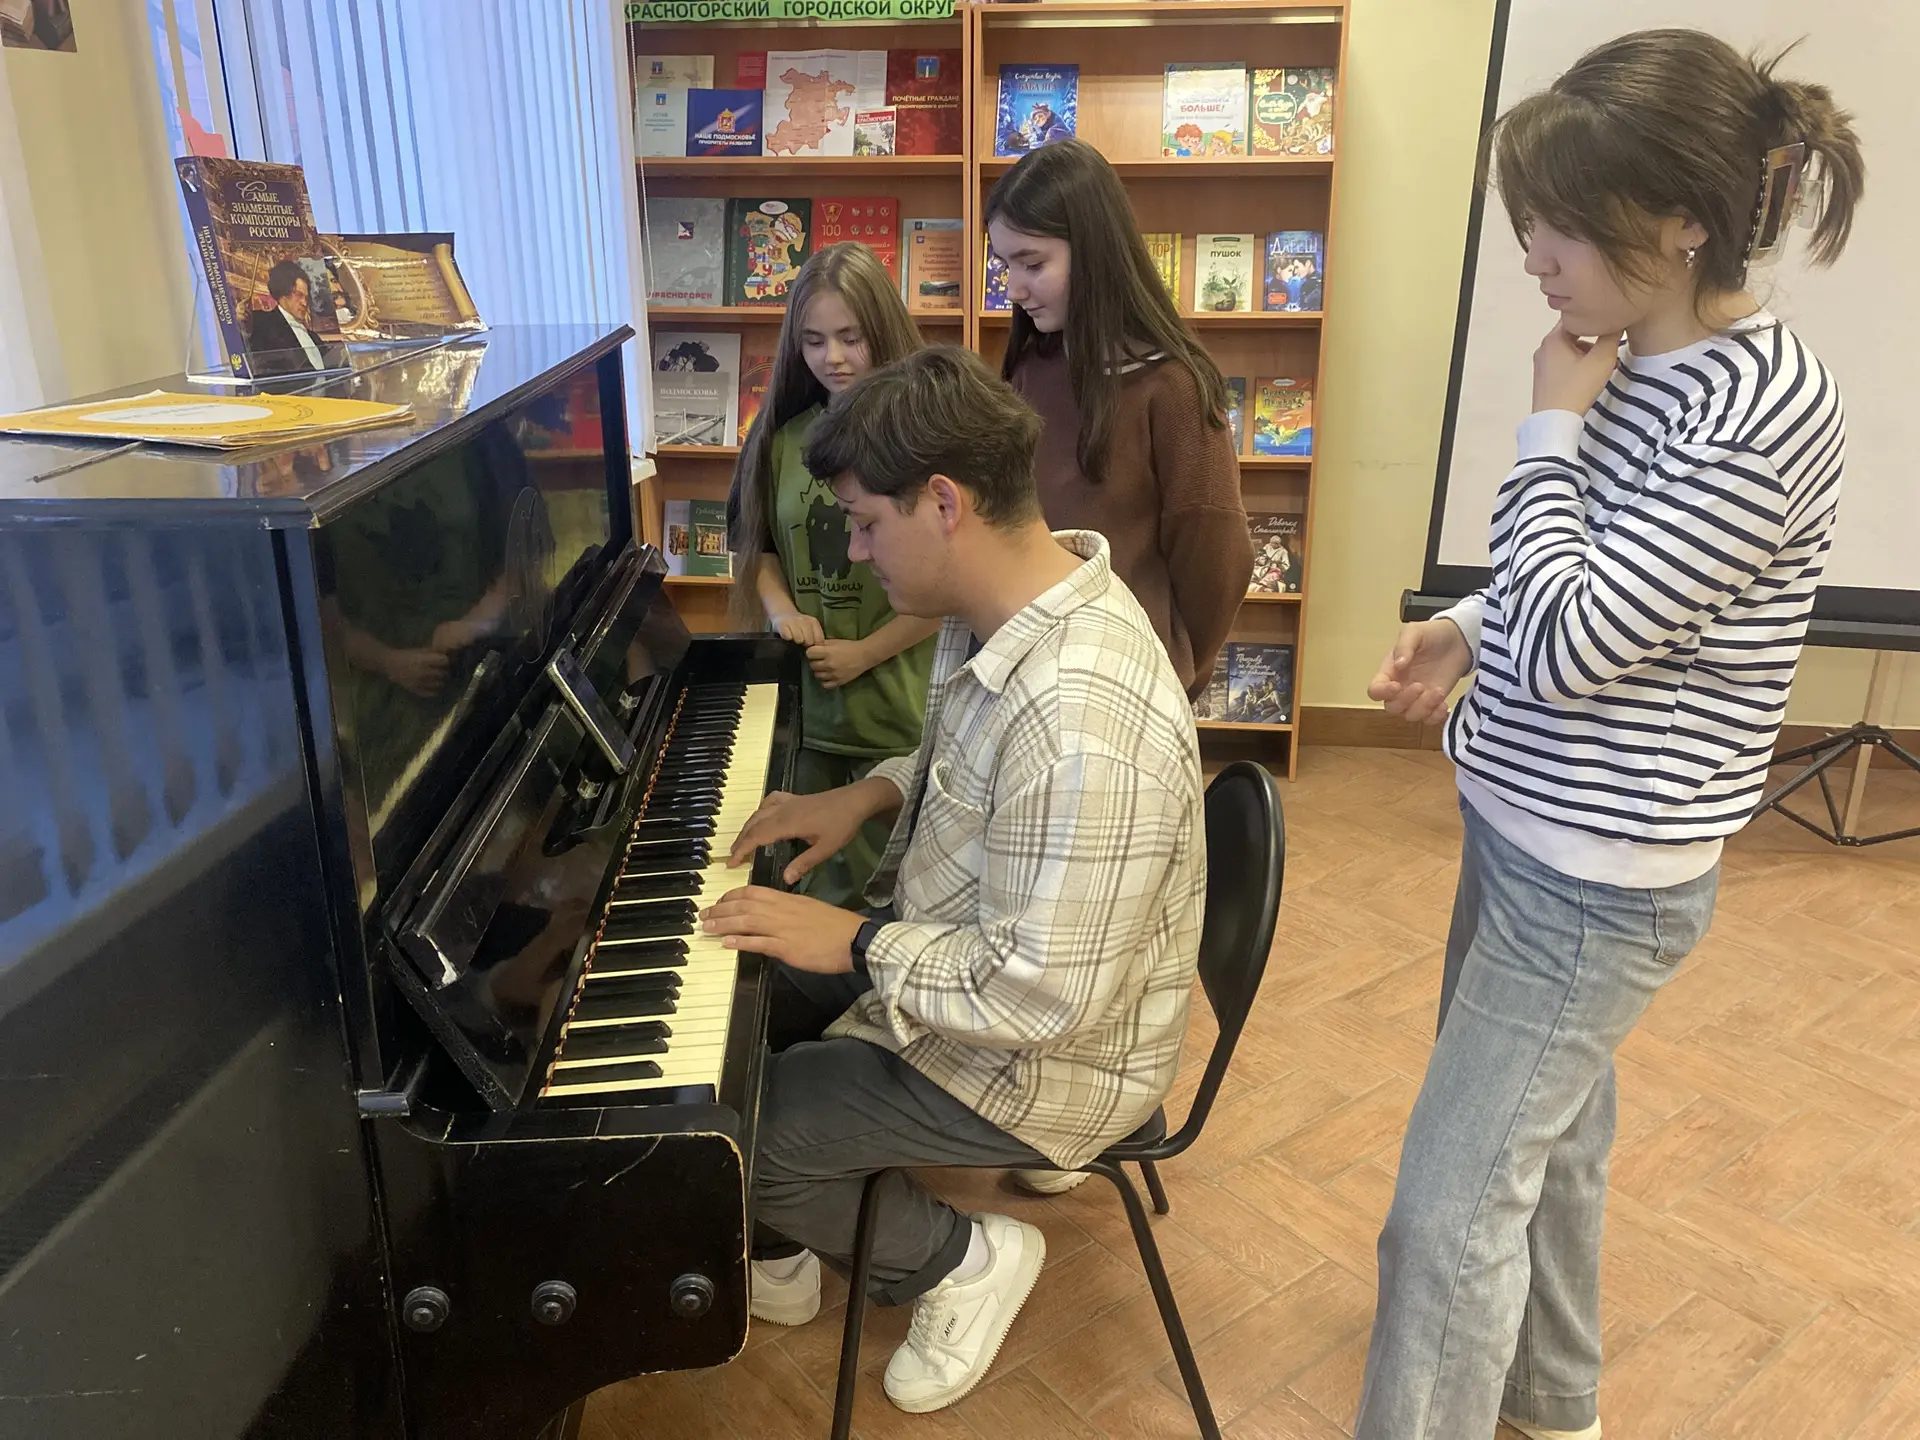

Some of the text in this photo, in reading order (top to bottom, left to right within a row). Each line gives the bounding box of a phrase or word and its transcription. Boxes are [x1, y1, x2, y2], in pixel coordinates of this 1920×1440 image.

[784, 0, 890, 18] ГОРОДСКОЙ
[900, 0, 955, 14] ОКРУГ
[892, 94, 926, 102] ПОЧЁТНЫЕ
[1180, 104, 1225, 113] БОЛЬШЕ!
[713, 133, 756, 141] ПОДМОСКОВЬЕ
[232, 202, 295, 216] ЗНАМЕНИТЫЕ
[230, 213, 301, 228] КОМПОЗИТОРЫ
[249, 227, 290, 239] РОССИИ
[821, 224, 842, 237] 100
[1150, 243, 1170, 258] ТОР
[1210, 250, 1242, 258] ПУШОК
[202, 225, 233, 325] КОМПОЗИТОРЫ РОССИИ
[660, 387, 720, 396] ПОДМОСКОВЬЕ
